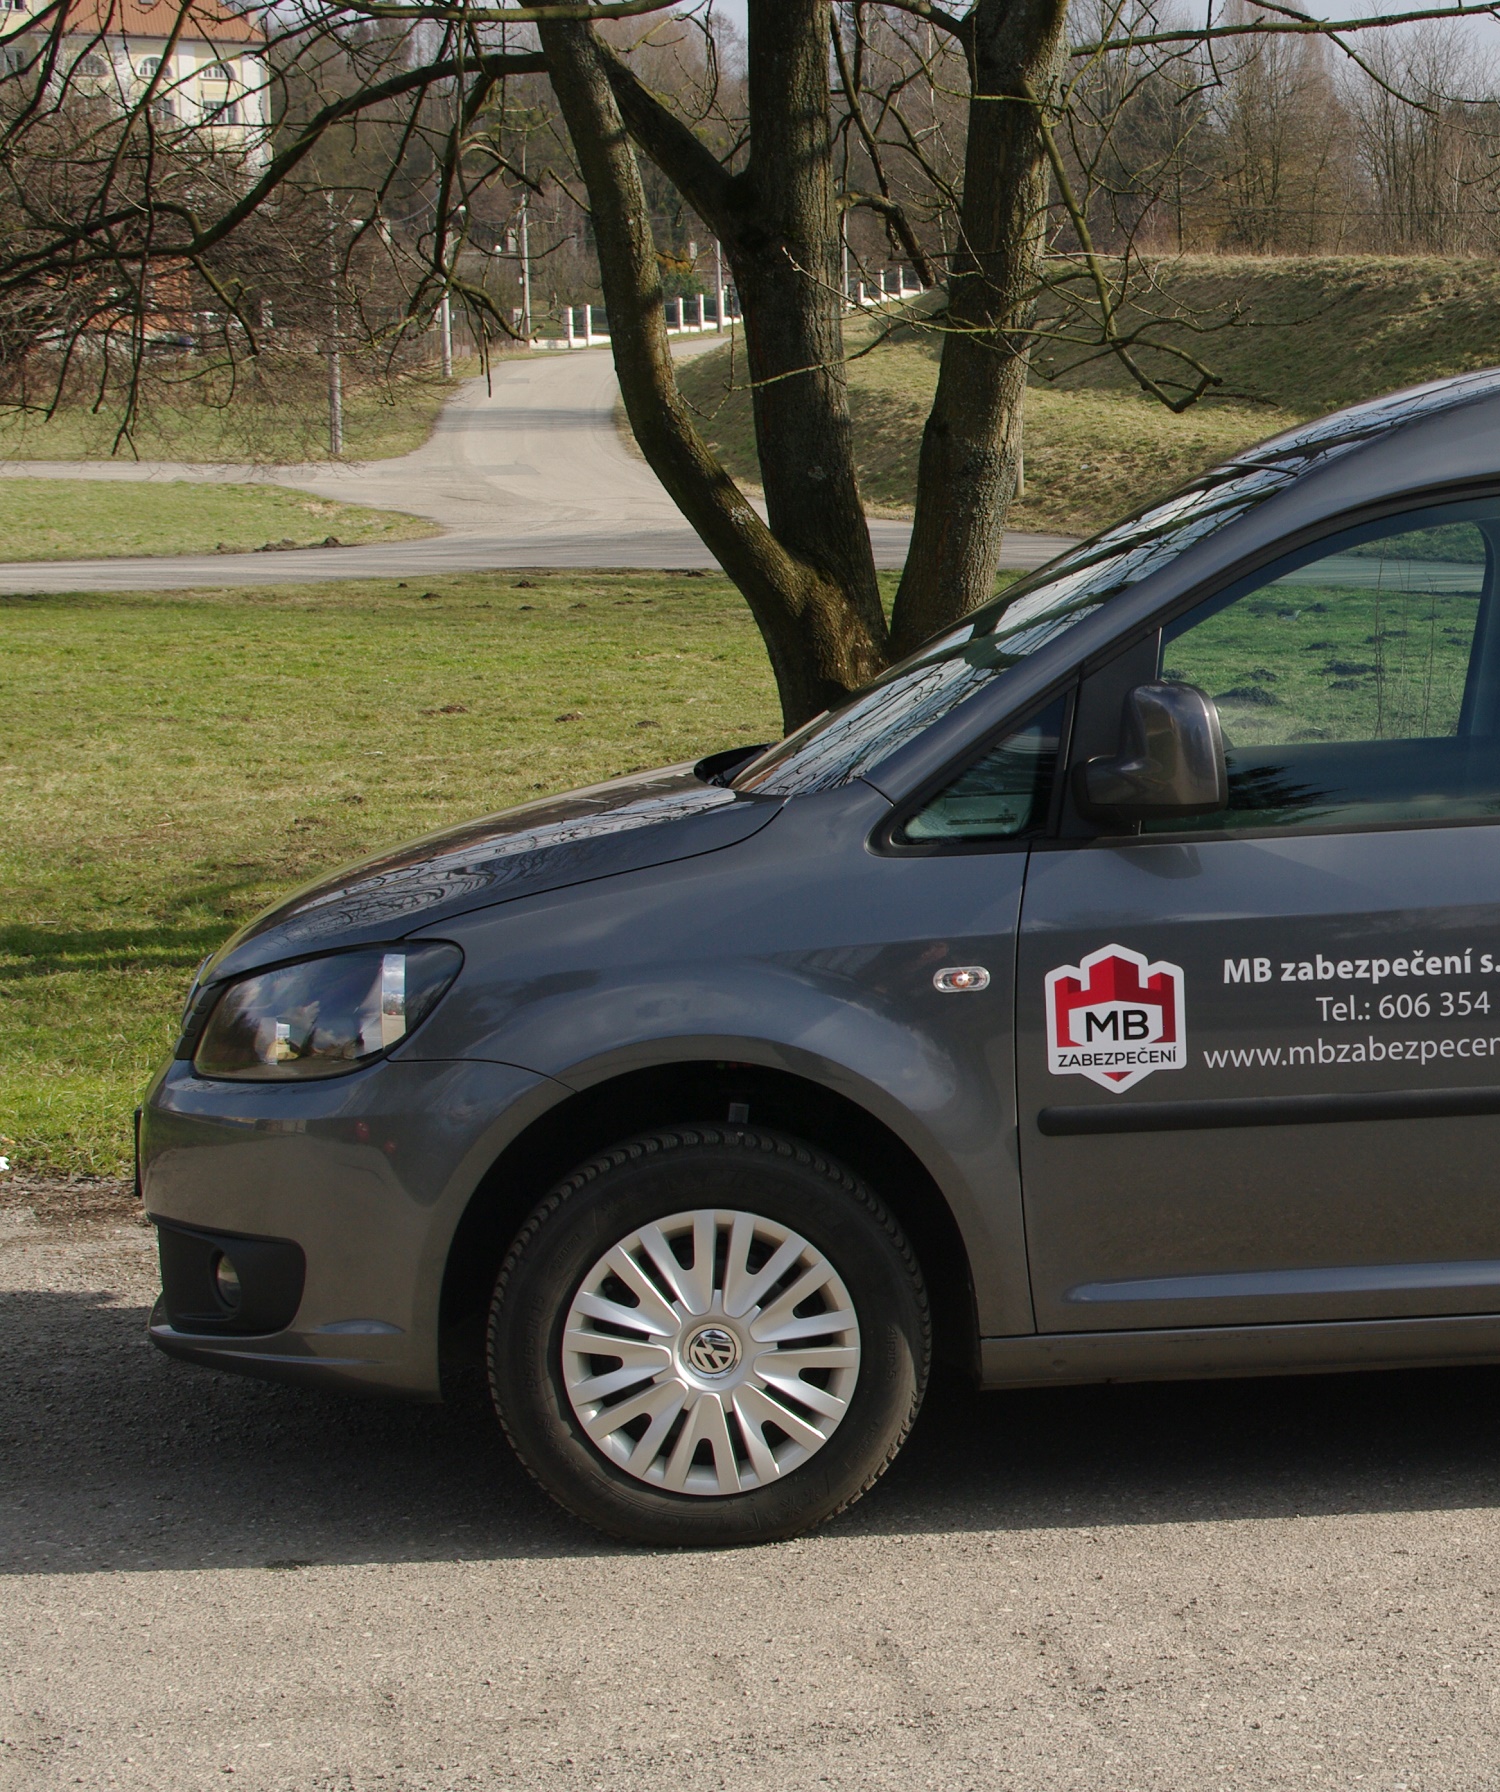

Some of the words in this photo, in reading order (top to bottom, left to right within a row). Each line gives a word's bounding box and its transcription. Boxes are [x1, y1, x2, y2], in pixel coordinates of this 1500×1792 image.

[1223, 957, 1273, 984] MB
[1280, 947, 1473, 985] zabezpečení
[1315, 994, 1371, 1022] Tel.:
[1378, 992, 1431, 1020] 606
[1439, 990, 1491, 1017] 354
[1085, 1009, 1150, 1043] MB
[1057, 1046, 1177, 1068] ZABEZPEČENÍ
